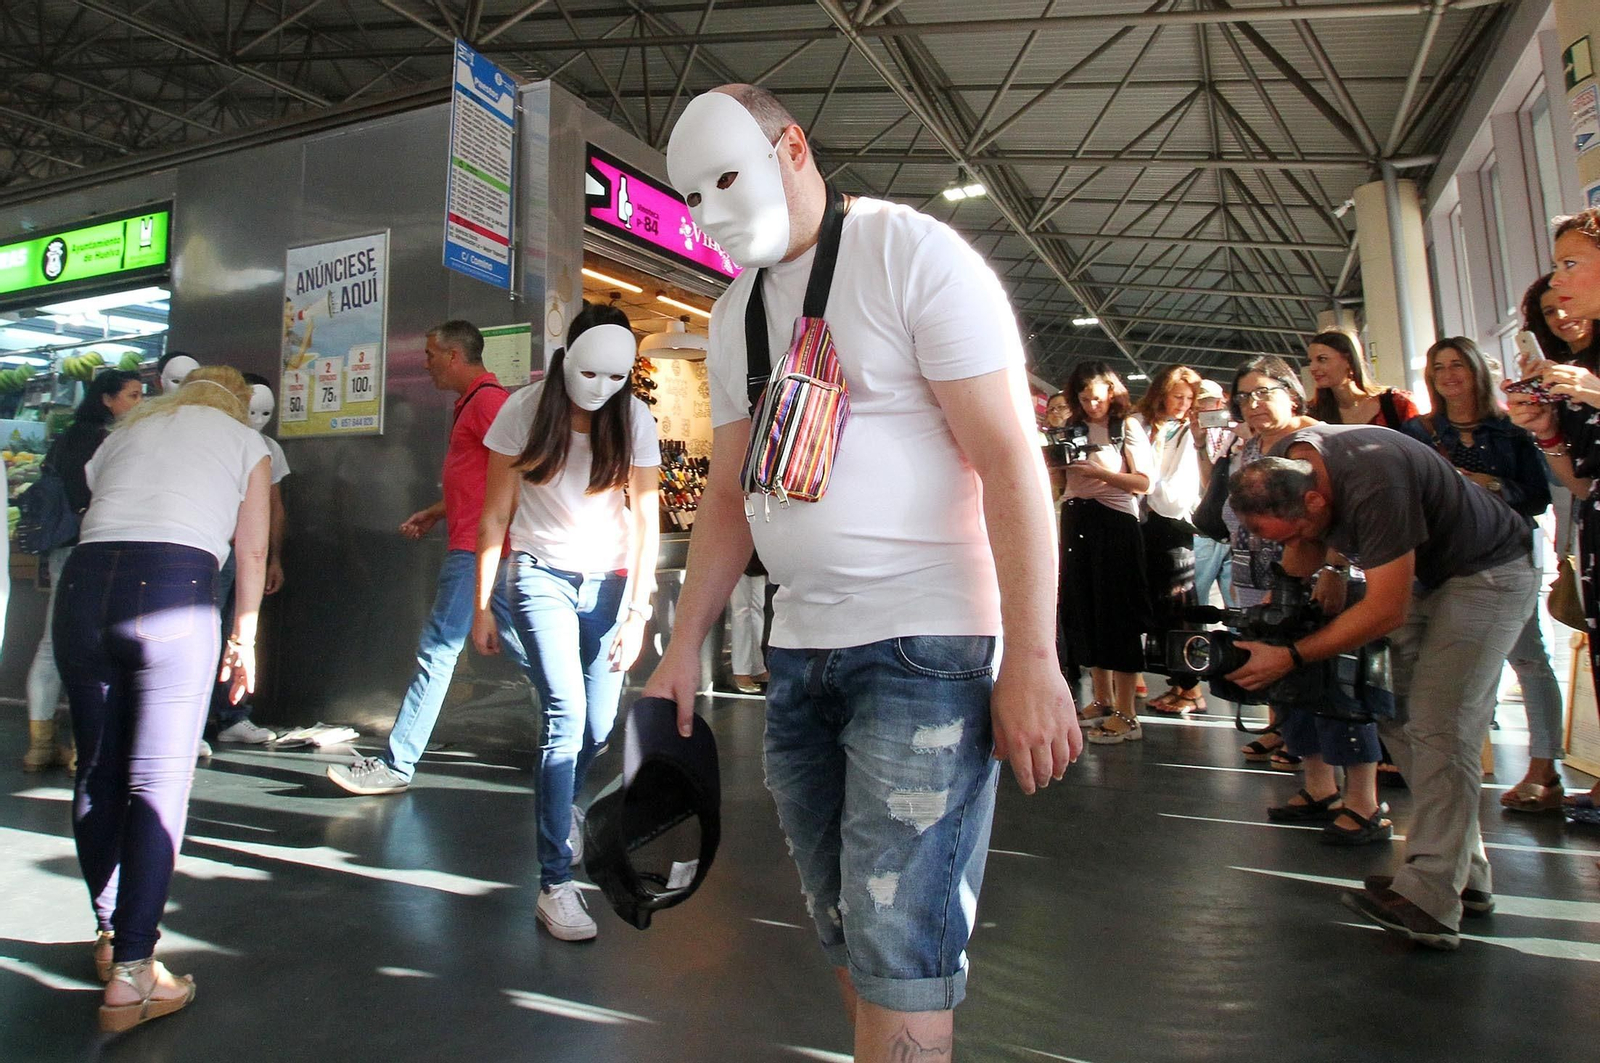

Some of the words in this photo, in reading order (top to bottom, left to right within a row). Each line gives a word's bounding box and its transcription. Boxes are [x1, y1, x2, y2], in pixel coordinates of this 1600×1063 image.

[72, 237, 121, 254] Ayuntamiento
[84, 253, 93, 262] de
[95, 249, 120, 260] Huelva
[296, 247, 377, 296] ANÚNCIESE
[340, 272, 378, 312] AQUÍ
[358, 351, 365, 363] 3
[325, 362, 332, 373] 2
[294, 373, 299, 383] 1
